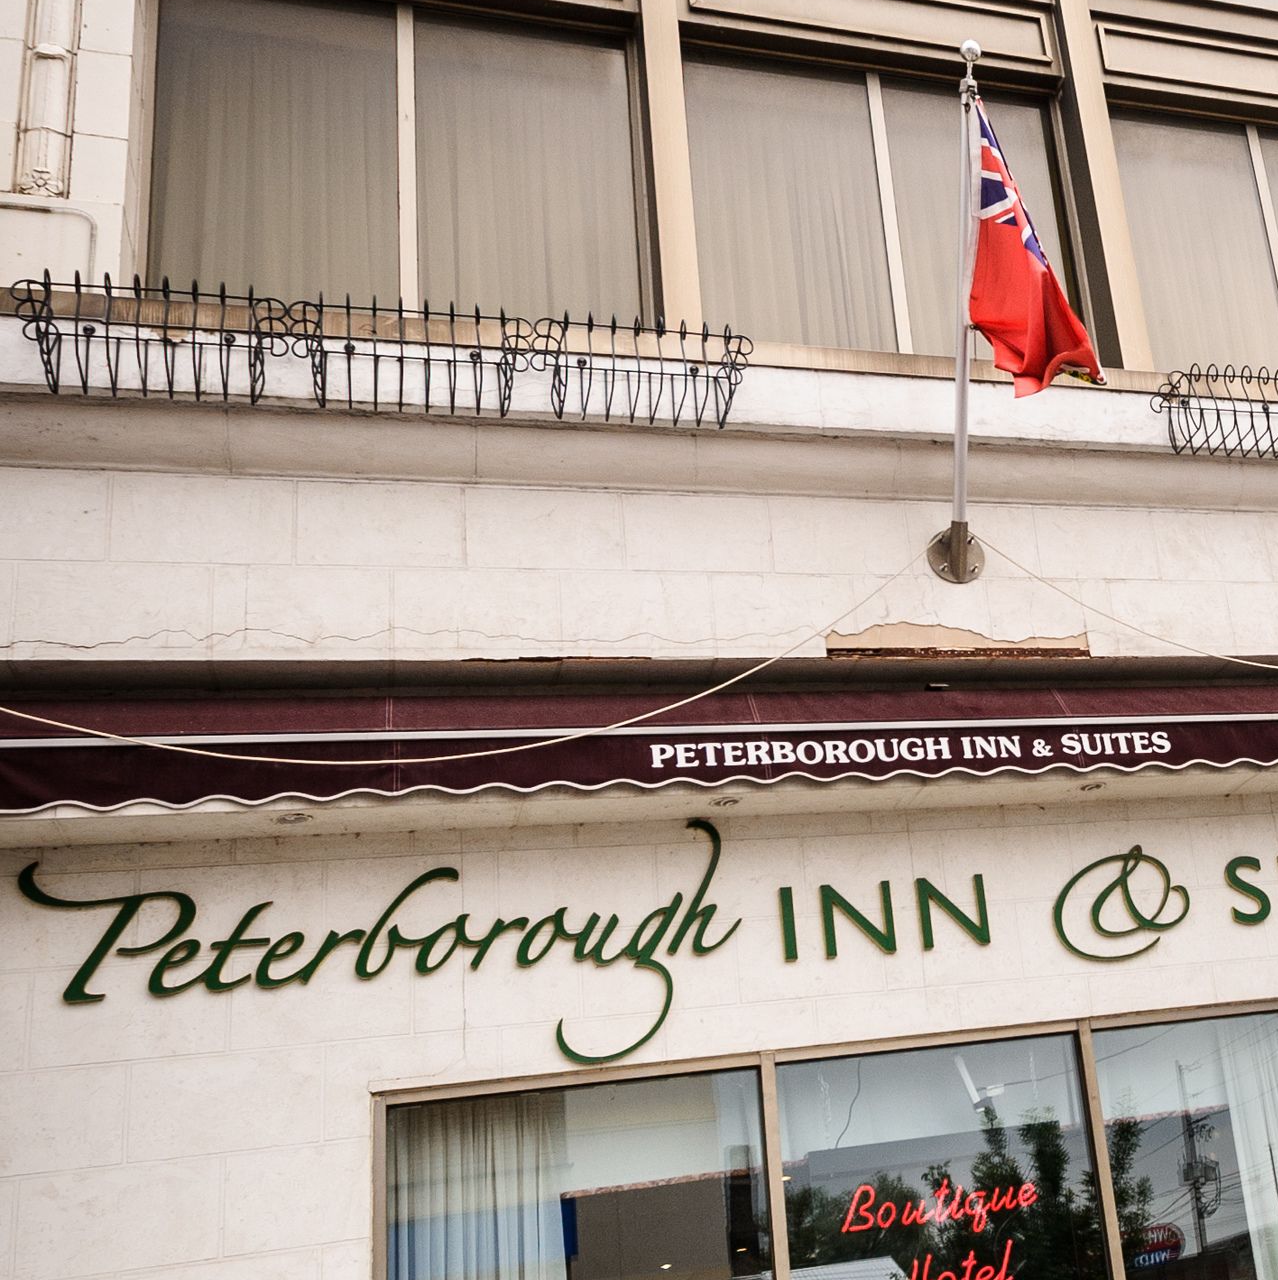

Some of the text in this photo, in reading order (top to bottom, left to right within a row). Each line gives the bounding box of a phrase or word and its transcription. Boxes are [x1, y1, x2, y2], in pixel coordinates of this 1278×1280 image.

[649, 731, 1172, 768] PETERBOROUGH INN & SUITES
[17, 817, 743, 1066] Peterborough
[777, 872, 991, 963] INN
[1053, 843, 1191, 963] &
[842, 1177, 1038, 1233] Boutique
